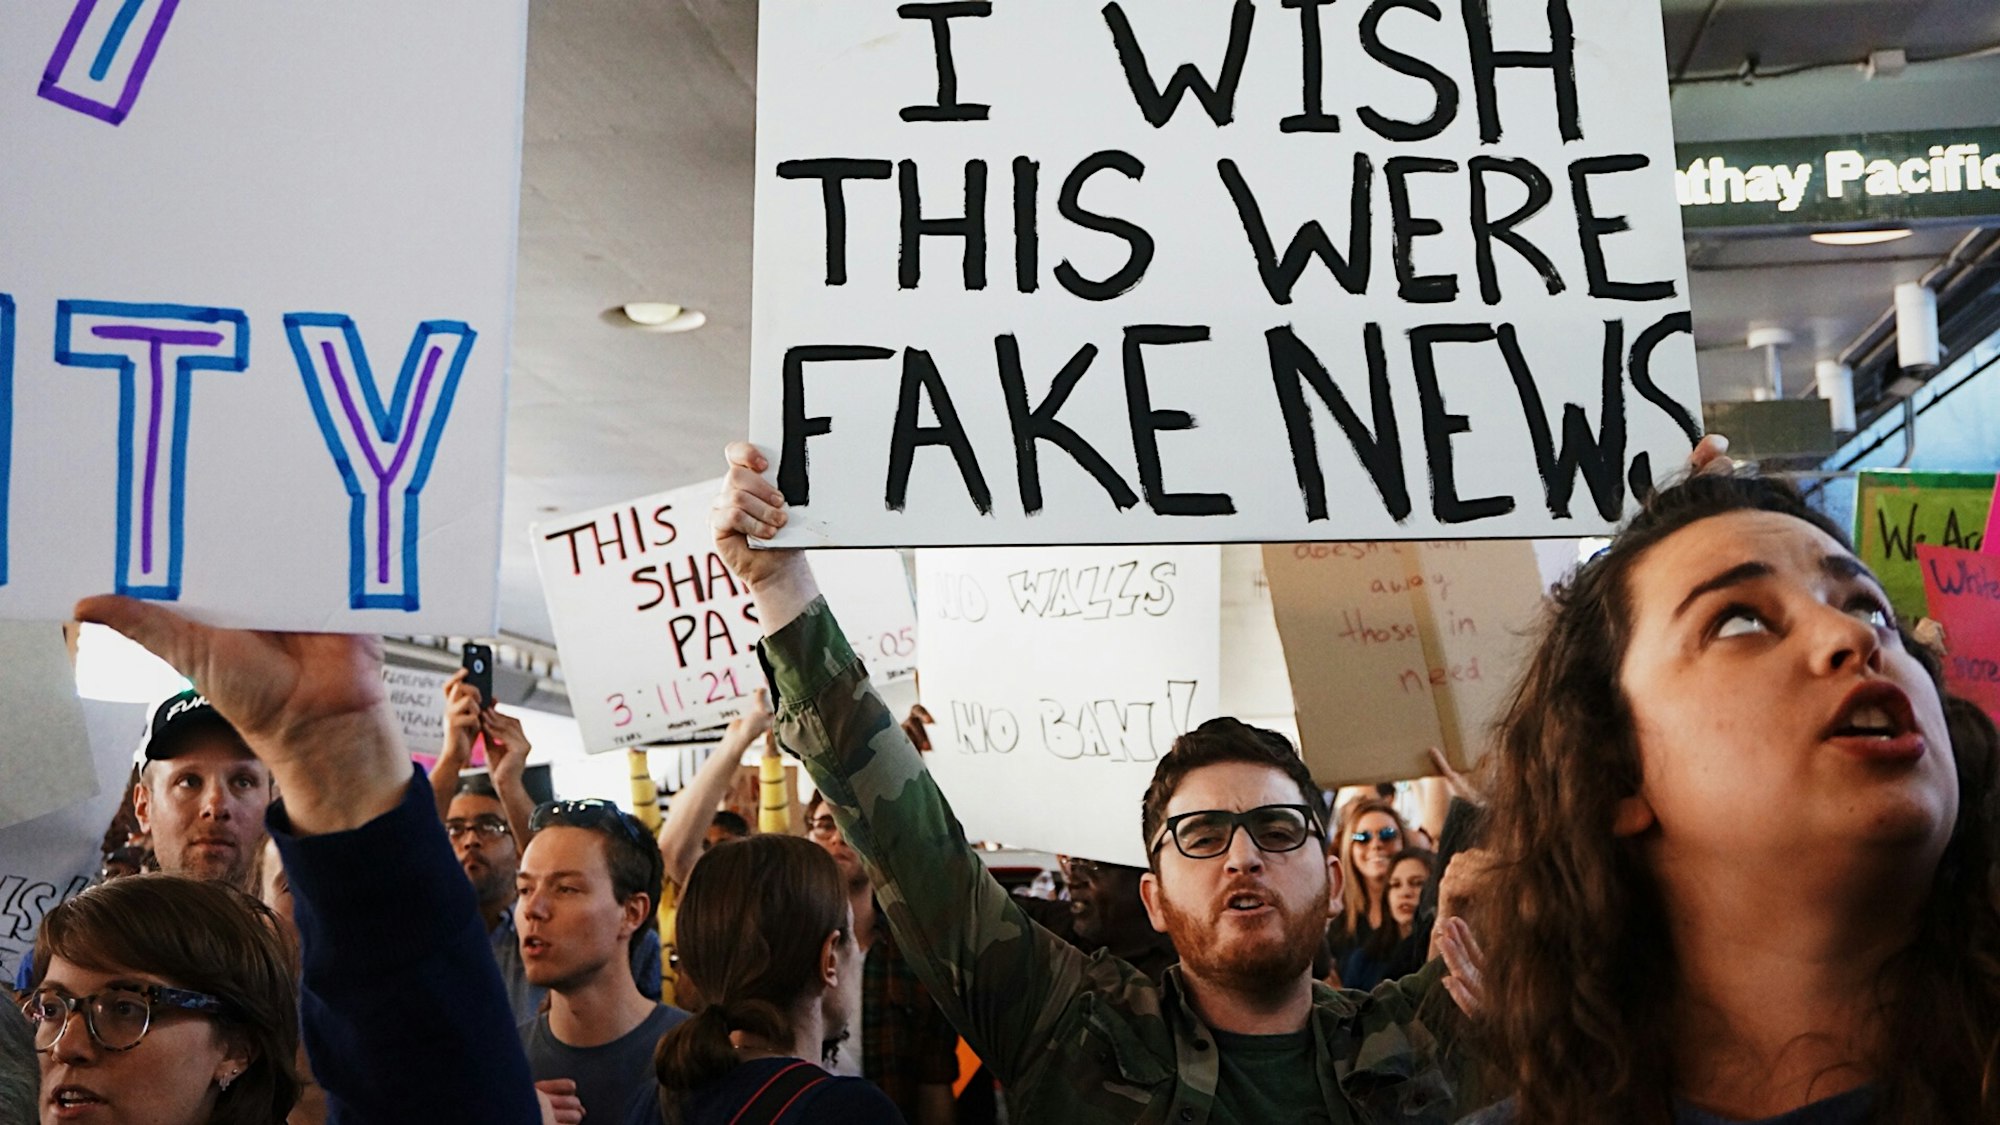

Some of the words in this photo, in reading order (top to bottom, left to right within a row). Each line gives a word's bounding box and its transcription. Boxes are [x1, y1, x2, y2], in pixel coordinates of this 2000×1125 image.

[898, 0, 993, 122] I
[1101, 0, 1586, 145] WISH
[776, 150, 1155, 302] THIS
[1217, 152, 1677, 306] WERE
[777, 324, 1237, 518] FAKE
[1265, 311, 1704, 525] NEWS
[0, 294, 478, 611] TY
[545, 504, 677, 575] THIS
[632, 552, 750, 611] SHA
[1007, 560, 1177, 621] WALLS
[1370, 574, 1449, 600] away
[1339, 608, 1416, 645] those
[1452, 610, 1477, 636] in
[1401, 657, 1481, 692] need
[951, 700, 1019, 755] NO
